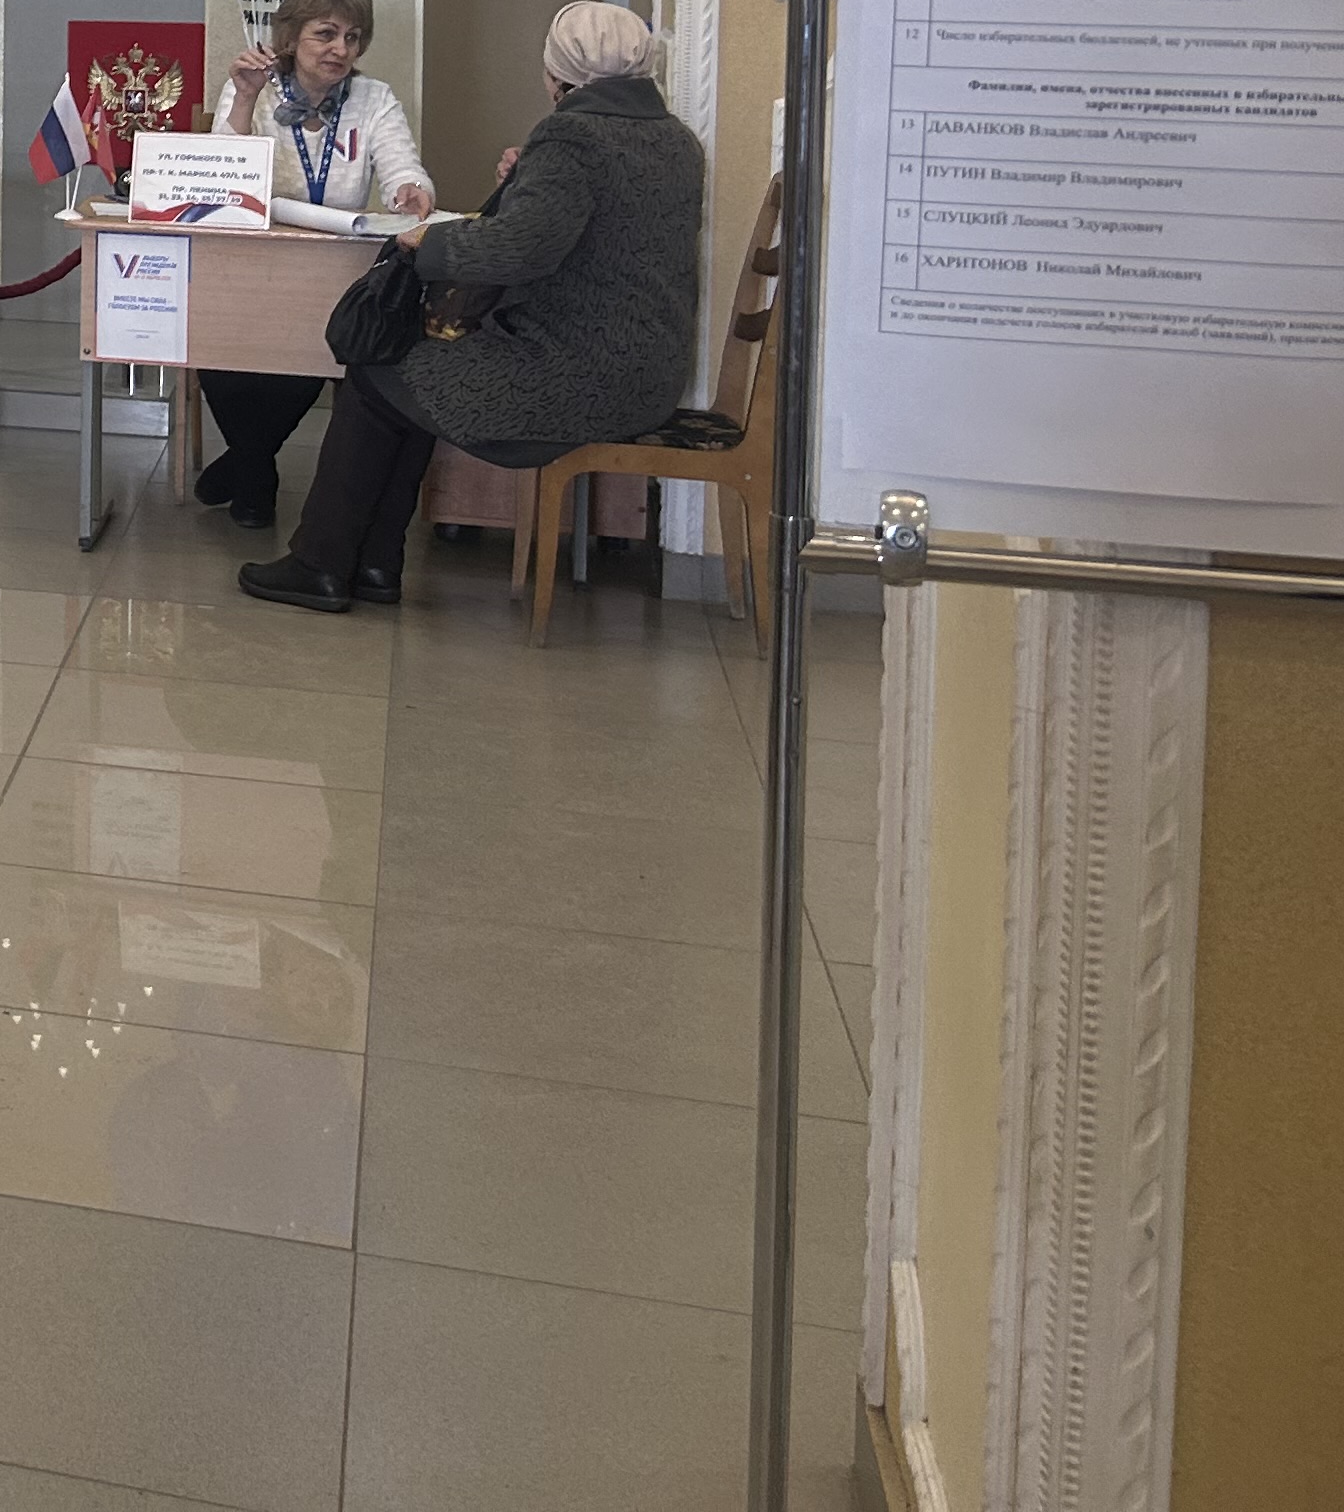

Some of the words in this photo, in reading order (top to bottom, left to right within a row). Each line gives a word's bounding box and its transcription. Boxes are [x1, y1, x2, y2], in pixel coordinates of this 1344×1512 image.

[901, 118, 915, 131] 13
[927, 119, 1025, 137] ДАВАНКОВ
[1029, 124, 1109, 139] Владислав
[1113, 127, 1198, 144] Андреевич
[898, 162, 913, 175] 14
[925, 164, 986, 181] ПУТИН
[991, 168, 1066, 186] Владимир
[1070, 171, 1184, 190] Владимирович
[896, 206, 911, 219] 15
[923, 208, 1009, 226] СЛУЦКИЙ
[1012, 214, 1069, 230] Леонид
[1073, 217, 1164, 234] Эдуардович
[894, 251, 909, 264] 16
[921, 253, 1028, 272] ХАРИТОНОВ
[1036, 259, 1102, 276] Николай
[1106, 263, 1203, 282] Михайлович
